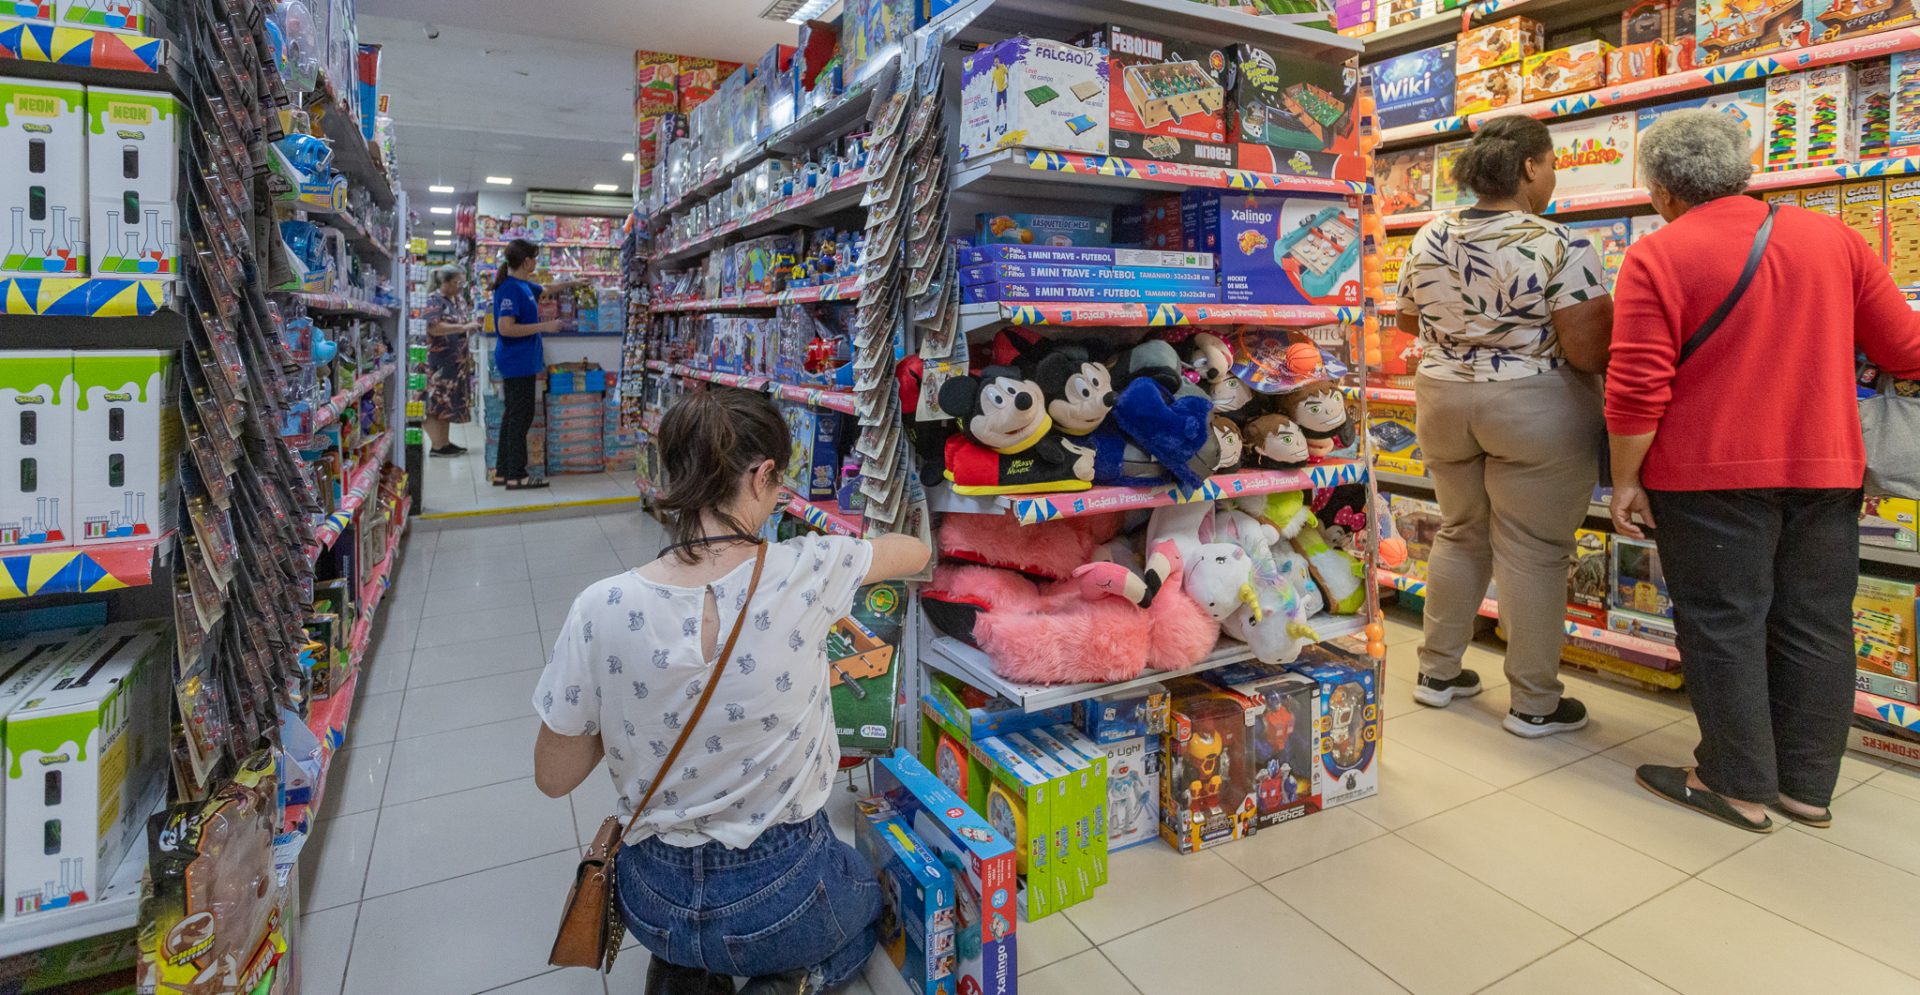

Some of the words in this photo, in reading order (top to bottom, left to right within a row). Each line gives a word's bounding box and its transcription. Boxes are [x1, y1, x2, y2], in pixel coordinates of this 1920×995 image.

[1111, 32, 1163, 60] PEBOLIM
[1813, 46, 1850, 60] Lojas
[1853, 37, 1901, 52] França
[1035, 47, 1083, 65] FALCÃO
[1084, 52, 1094, 68] 12
[1380, 71, 1432, 103] Wiki
[18, 97, 55, 113] NEON
[112, 105, 147, 121] NEON
[1194, 145, 1232, 161] PEBOLIM
[1554, 147, 1617, 171] ABULEIRO
[1160, 165, 1188, 177] Lojas
[1188, 169, 1222, 181] França
[1303, 177, 1335, 186] França
[1806, 188, 1837, 200] CAIU
[1846, 184, 1880, 197] CAIU
[1231, 209, 1273, 224] Xalingo
[1033, 251, 1051, 260] MINI
[1052, 252, 1075, 260] TRAVE
[1081, 253, 1112, 262] FUTEBOL
[1008, 270, 1025, 278] Filhos
[1036, 268, 1059, 277] MINI
[1062, 269, 1090, 278] TRAVE
[1098, 270, 1136, 279] FUTEBOL
[1140, 271, 1174, 280] TAMANHO:
[1041, 287, 1064, 297] MINI
[1067, 288, 1095, 297] TRAVE
[1103, 288, 1142, 298] FUTEBOL
[1145, 290, 1178, 298] TAMANHO:
[1344, 285, 1357, 296] 24
[1076, 309, 1107, 321] Lojas
[1107, 308, 1143, 321] França
[1272, 308, 1295, 319] Lojas
[1297, 309, 1326, 321] França
[1243, 477, 1268, 489] Lojas
[1269, 474, 1300, 487] França
[1087, 495, 1117, 509] Lojas
[1118, 492, 1154, 505] França
[1117, 744, 1142, 757] Light
[1271, 808, 1305, 825] FORCE
[168, 934, 216, 966] CHOMP
[996, 944, 1008, 995] Xalingo
